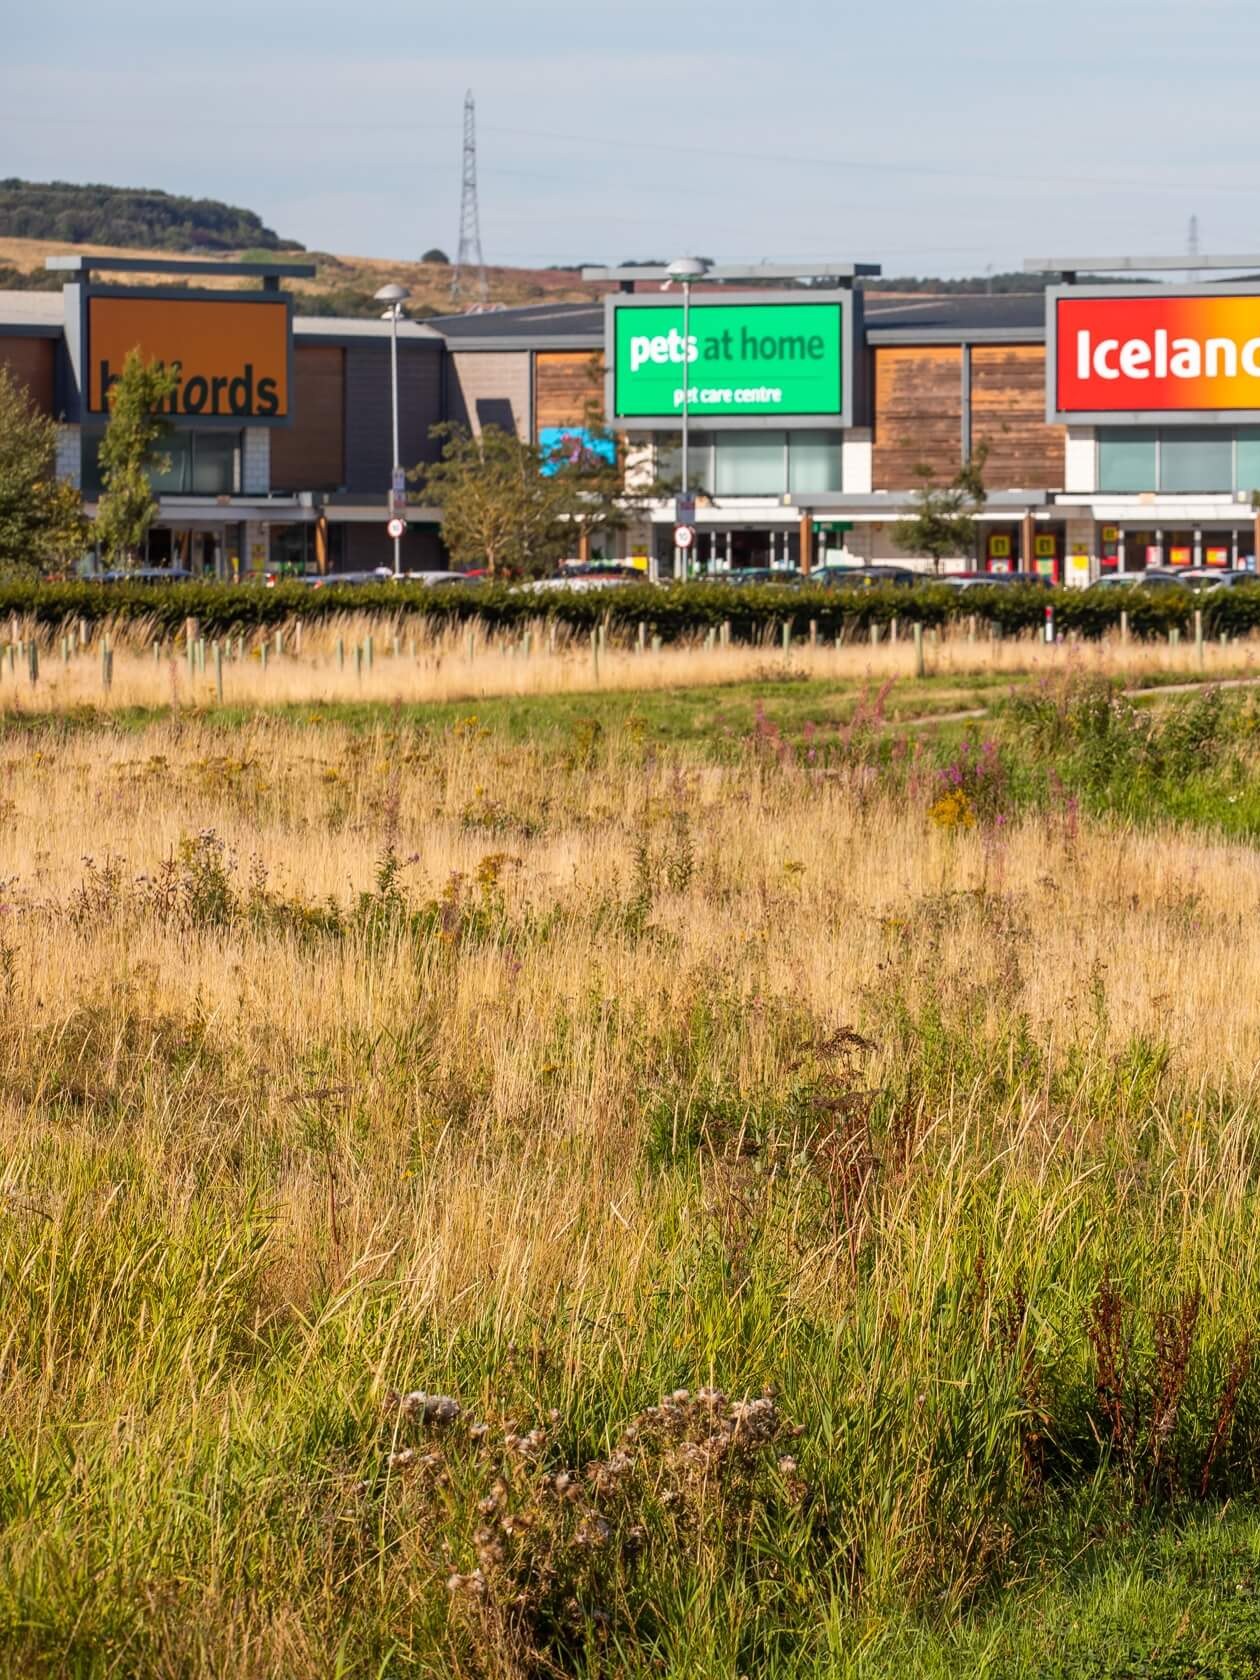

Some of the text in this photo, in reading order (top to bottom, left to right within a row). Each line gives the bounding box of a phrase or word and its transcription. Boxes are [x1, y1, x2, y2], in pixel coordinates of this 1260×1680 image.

[630, 326, 825, 371] pets at home
[101, 358, 280, 416] hfords
[673, 386, 782, 407] pet care centre
